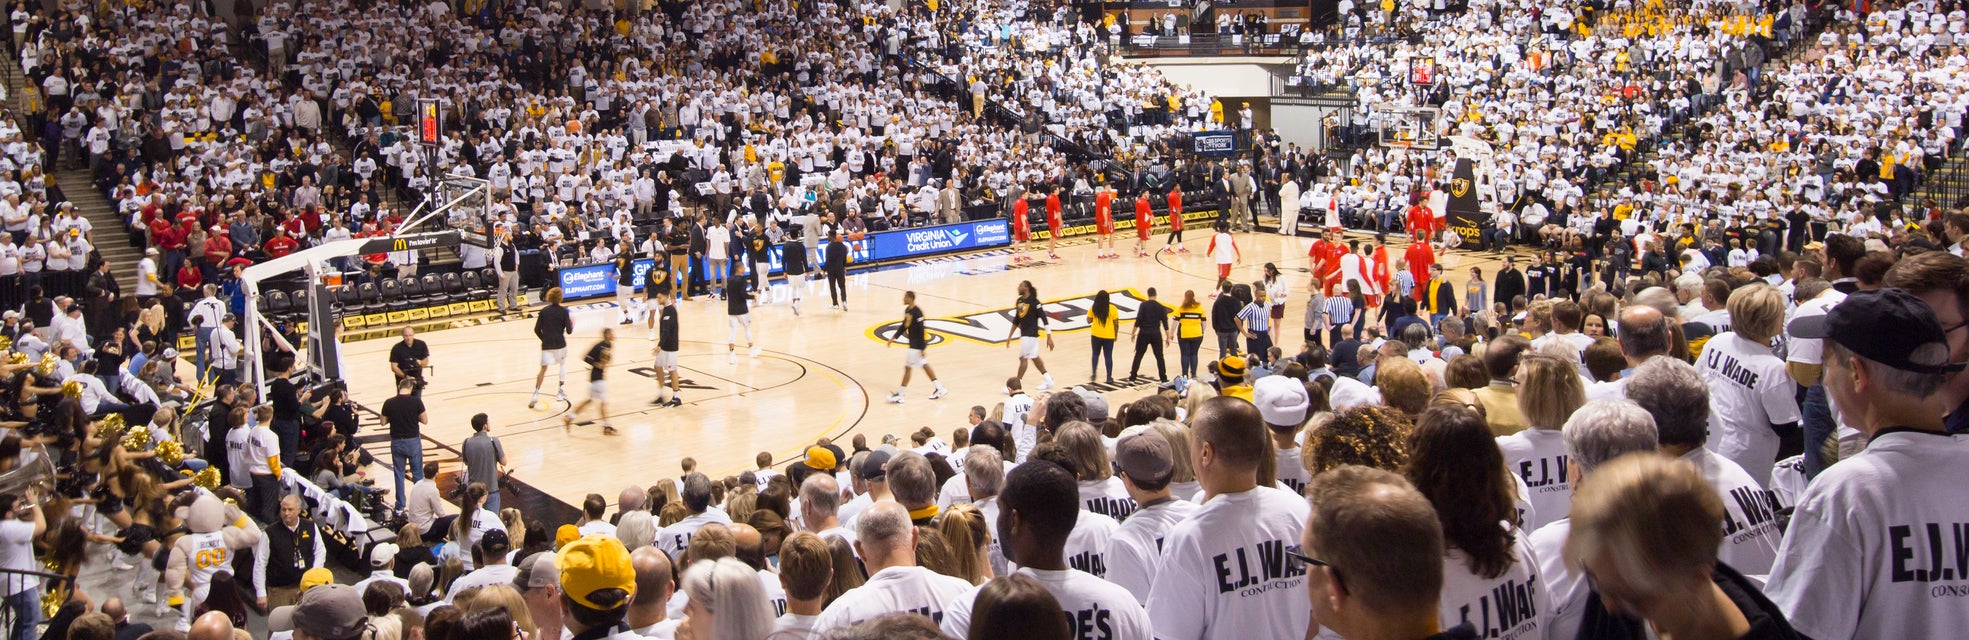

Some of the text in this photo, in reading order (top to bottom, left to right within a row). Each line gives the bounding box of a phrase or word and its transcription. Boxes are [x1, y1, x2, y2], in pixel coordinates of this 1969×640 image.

[906, 229, 946, 244] VIRGINIA
[1452, 226, 1480, 239] rop's
[907, 239, 953, 252] Credit Union.
[573, 270, 604, 282] Elephant
[565, 284, 606, 294] ELEPHANT.COM
[1721, 355, 1758, 390] WADE
[1519, 458, 1553, 487] E.J.
[196, 547, 226, 570] 00
[1889, 523, 1953, 582] E.J.
[1213, 547, 1258, 594] E.J.
[1063, 602, 1112, 640] DE'S
